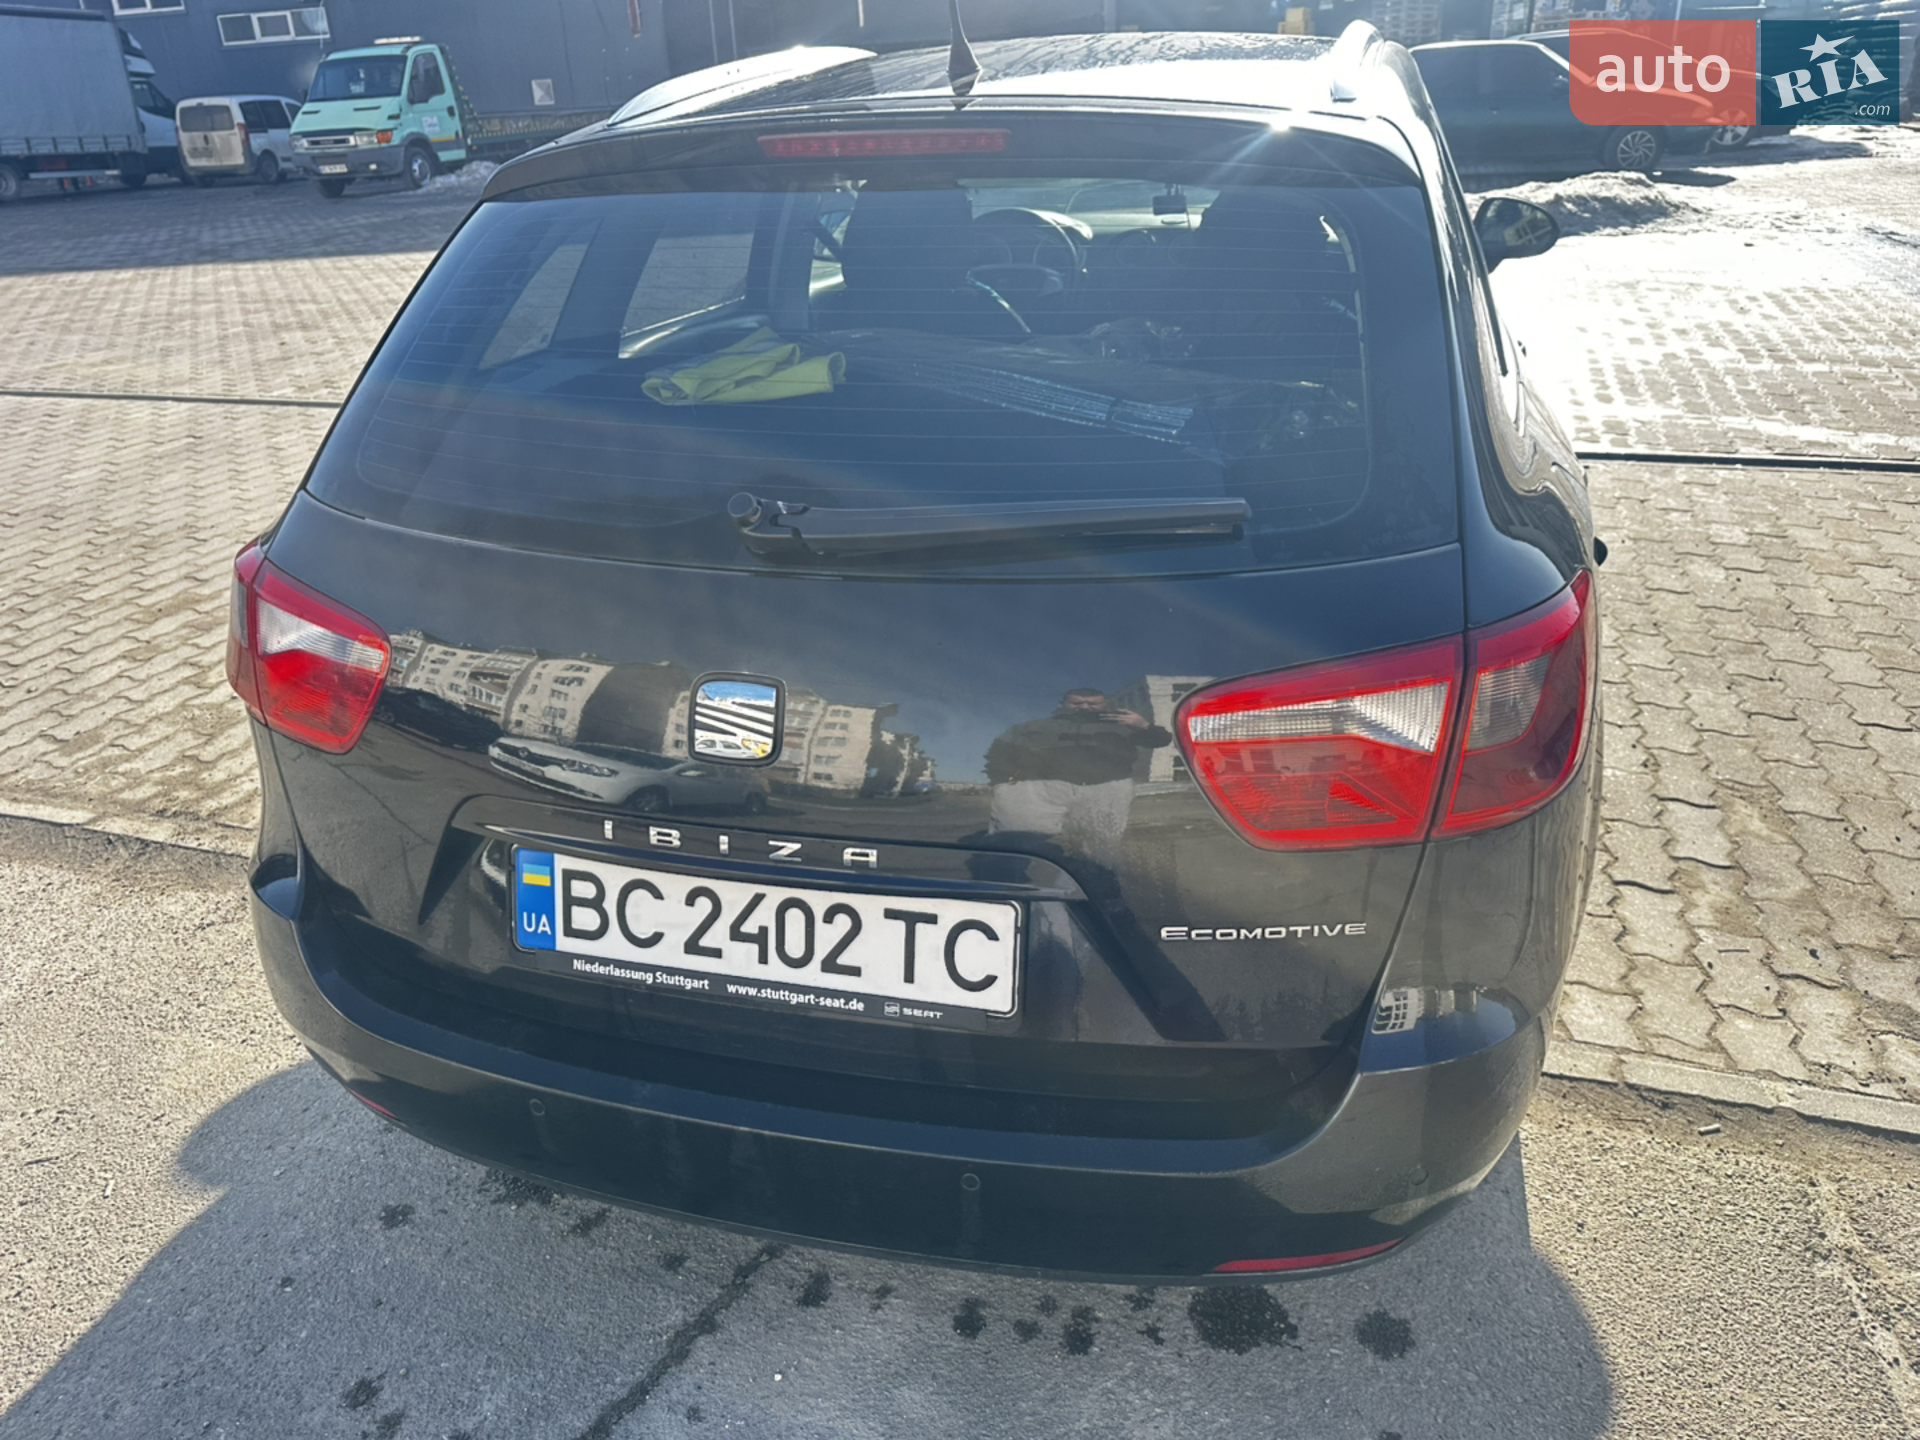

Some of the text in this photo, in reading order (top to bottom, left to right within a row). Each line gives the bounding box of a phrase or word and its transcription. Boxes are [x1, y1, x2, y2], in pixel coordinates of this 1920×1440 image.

[604, 820, 878, 867] IBIZA
[523, 911, 552, 935] UA
[562, 868, 1000, 992] BC 2402 TC
[573, 959, 709, 991] Niederlassung Stuttgart
[727, 982, 865, 1011] www.stuttgart-seat.de
[902, 1007, 943, 1019] SEAT
